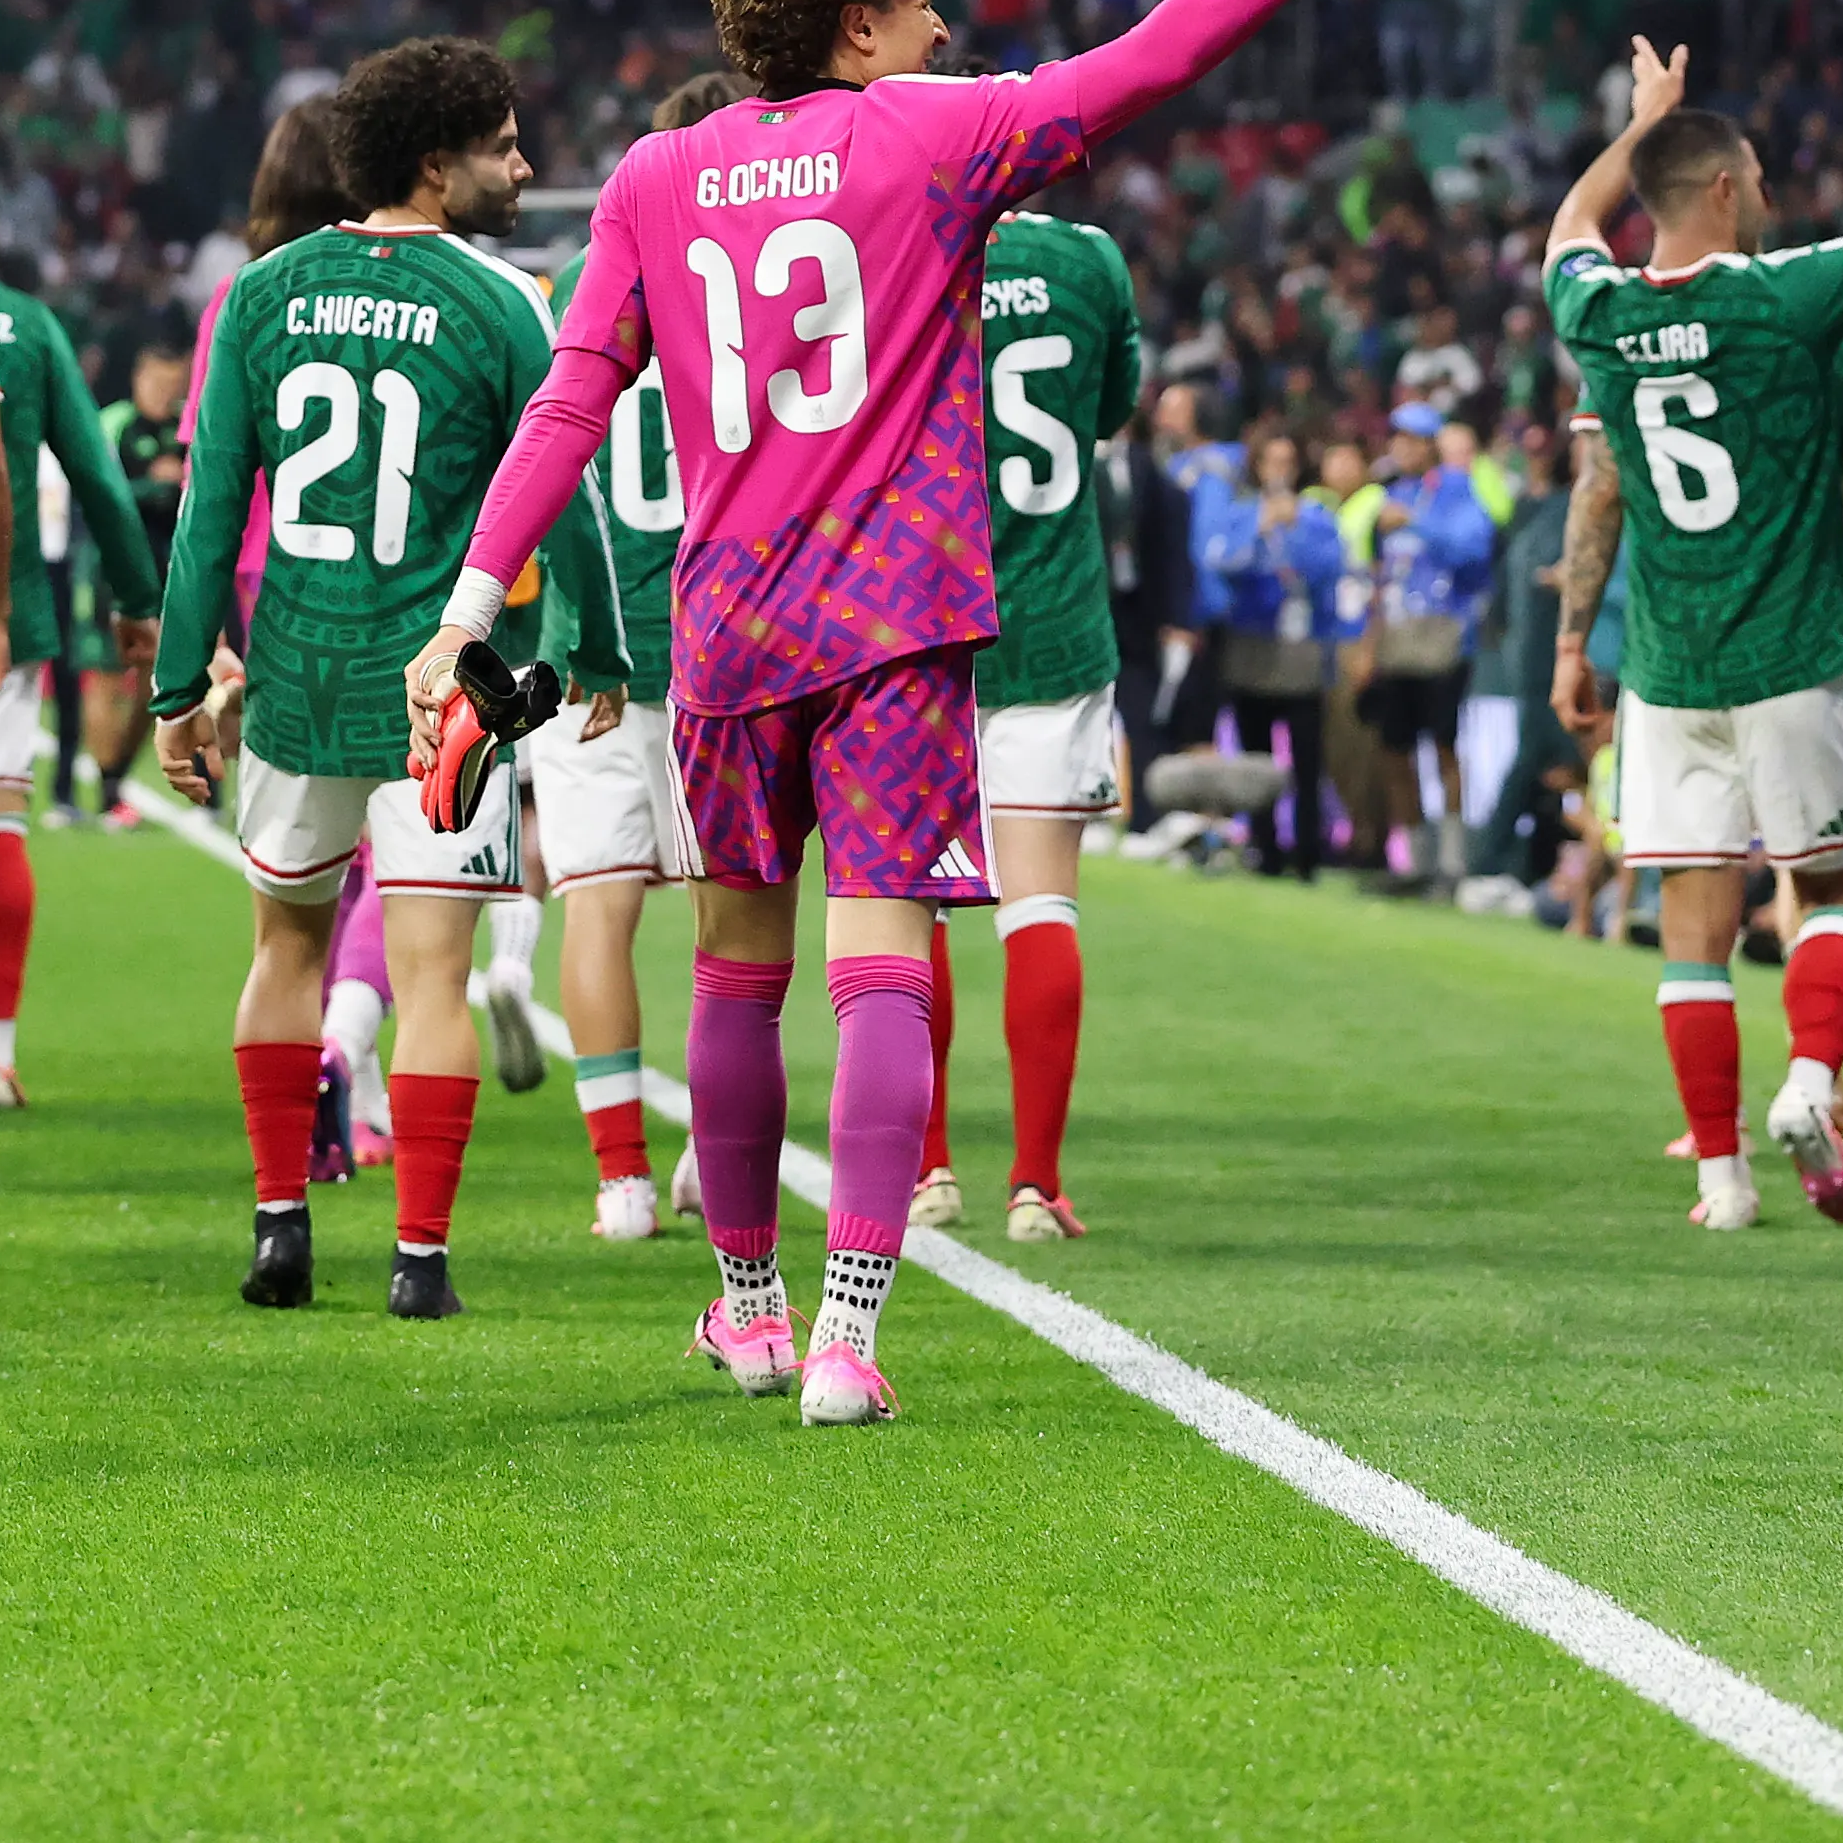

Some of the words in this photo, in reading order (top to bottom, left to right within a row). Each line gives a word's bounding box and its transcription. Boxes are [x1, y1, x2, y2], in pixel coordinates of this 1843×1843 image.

[695, 151, 841, 209] G.OCHOA
[287, 295, 440, 347] C.HUERTA
[686, 218, 869, 454] 13
[981, 275, 1051, 320] EYES
[271, 361, 422, 566] 21
[990, 334, 1080, 516] 5
[1632, 372, 1741, 533] 6
